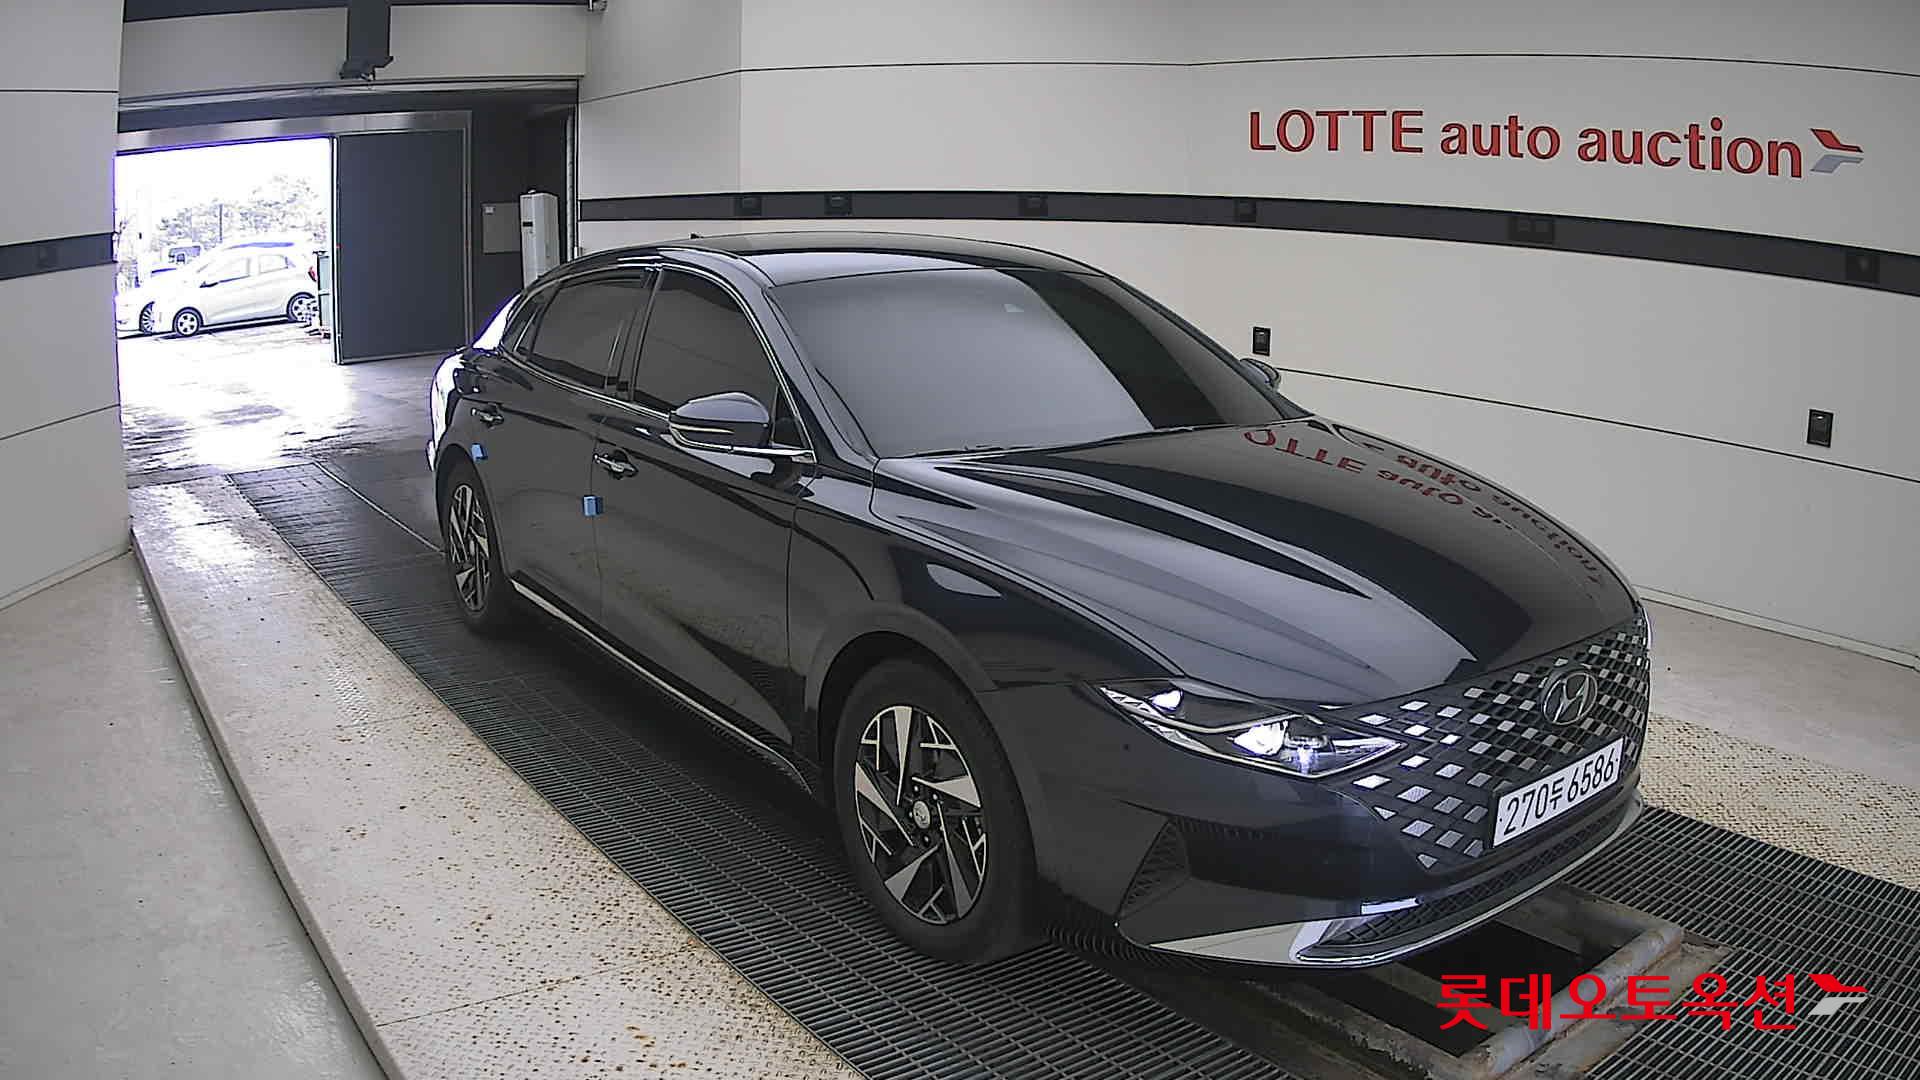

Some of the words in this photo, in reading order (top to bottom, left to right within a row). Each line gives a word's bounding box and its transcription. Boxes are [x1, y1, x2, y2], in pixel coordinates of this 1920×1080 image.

[1249, 109, 1425, 154] LOTTE
[1440, 115, 1561, 160] auto
[1576, 116, 1803, 180] auction
